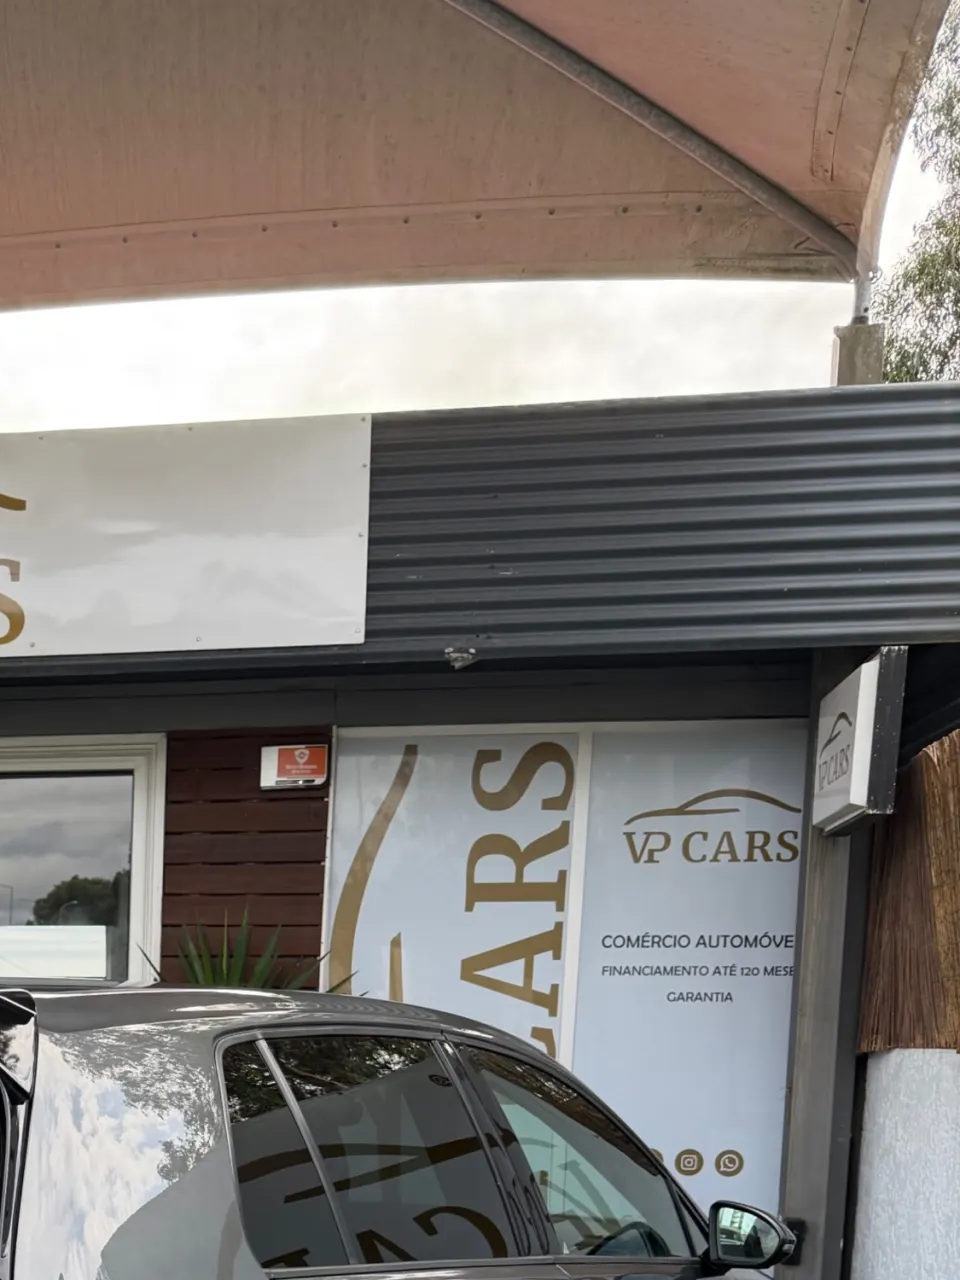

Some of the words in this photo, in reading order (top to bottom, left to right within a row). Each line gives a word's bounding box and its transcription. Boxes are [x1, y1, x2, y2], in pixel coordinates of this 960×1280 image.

[623, 831, 672, 863] VP
[681, 829, 800, 862] CARS
[460, 741, 575, 1060] ARS
[601, 932, 691, 949] COMÉRCIO
[601, 965, 709, 977] FINANCIAMENTO
[712, 963, 737, 977] ATÉ
[740, 967, 760, 977] 120
[666, 991, 734, 1003] GARANTIA
